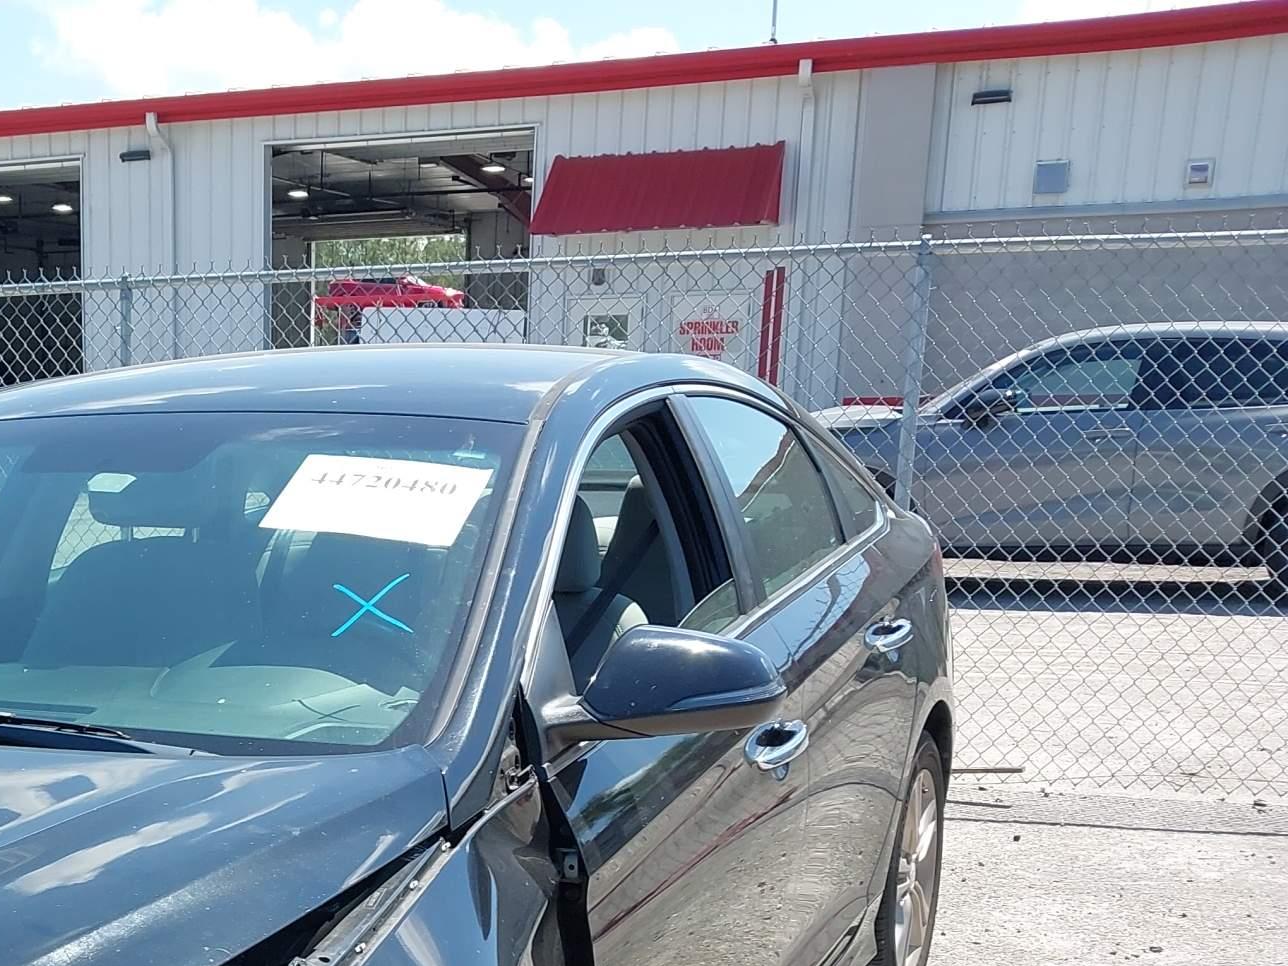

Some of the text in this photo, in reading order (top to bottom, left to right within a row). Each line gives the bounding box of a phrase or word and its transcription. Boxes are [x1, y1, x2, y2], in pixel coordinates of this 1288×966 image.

[679, 320, 739, 335] SPRINKLER
[691, 337, 725, 352] ROOM
[312, 471, 457, 496] 44720480
